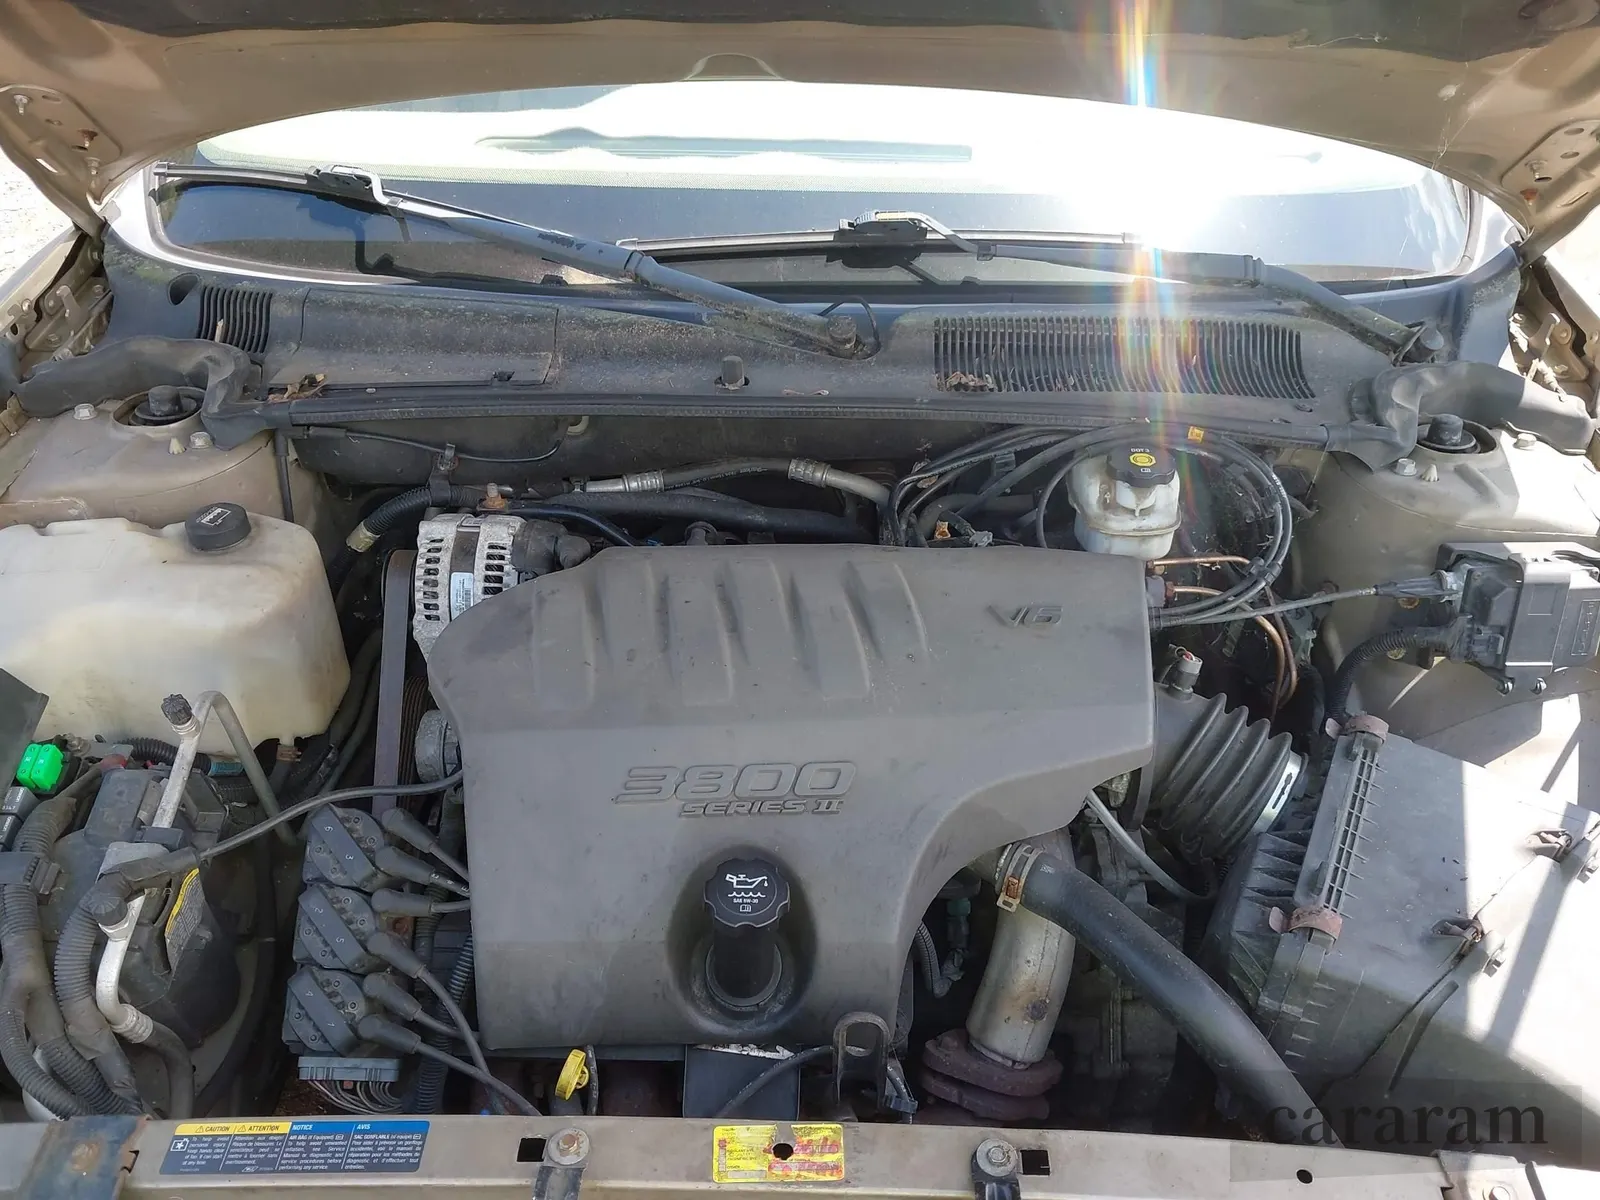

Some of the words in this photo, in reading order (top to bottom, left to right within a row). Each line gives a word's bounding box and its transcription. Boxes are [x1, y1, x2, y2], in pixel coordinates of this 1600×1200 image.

[986, 605, 1063, 628] V6
[614, 760, 857, 803] 3800
[679, 800, 806, 818] SERIES
[811, 798, 843, 815] II
